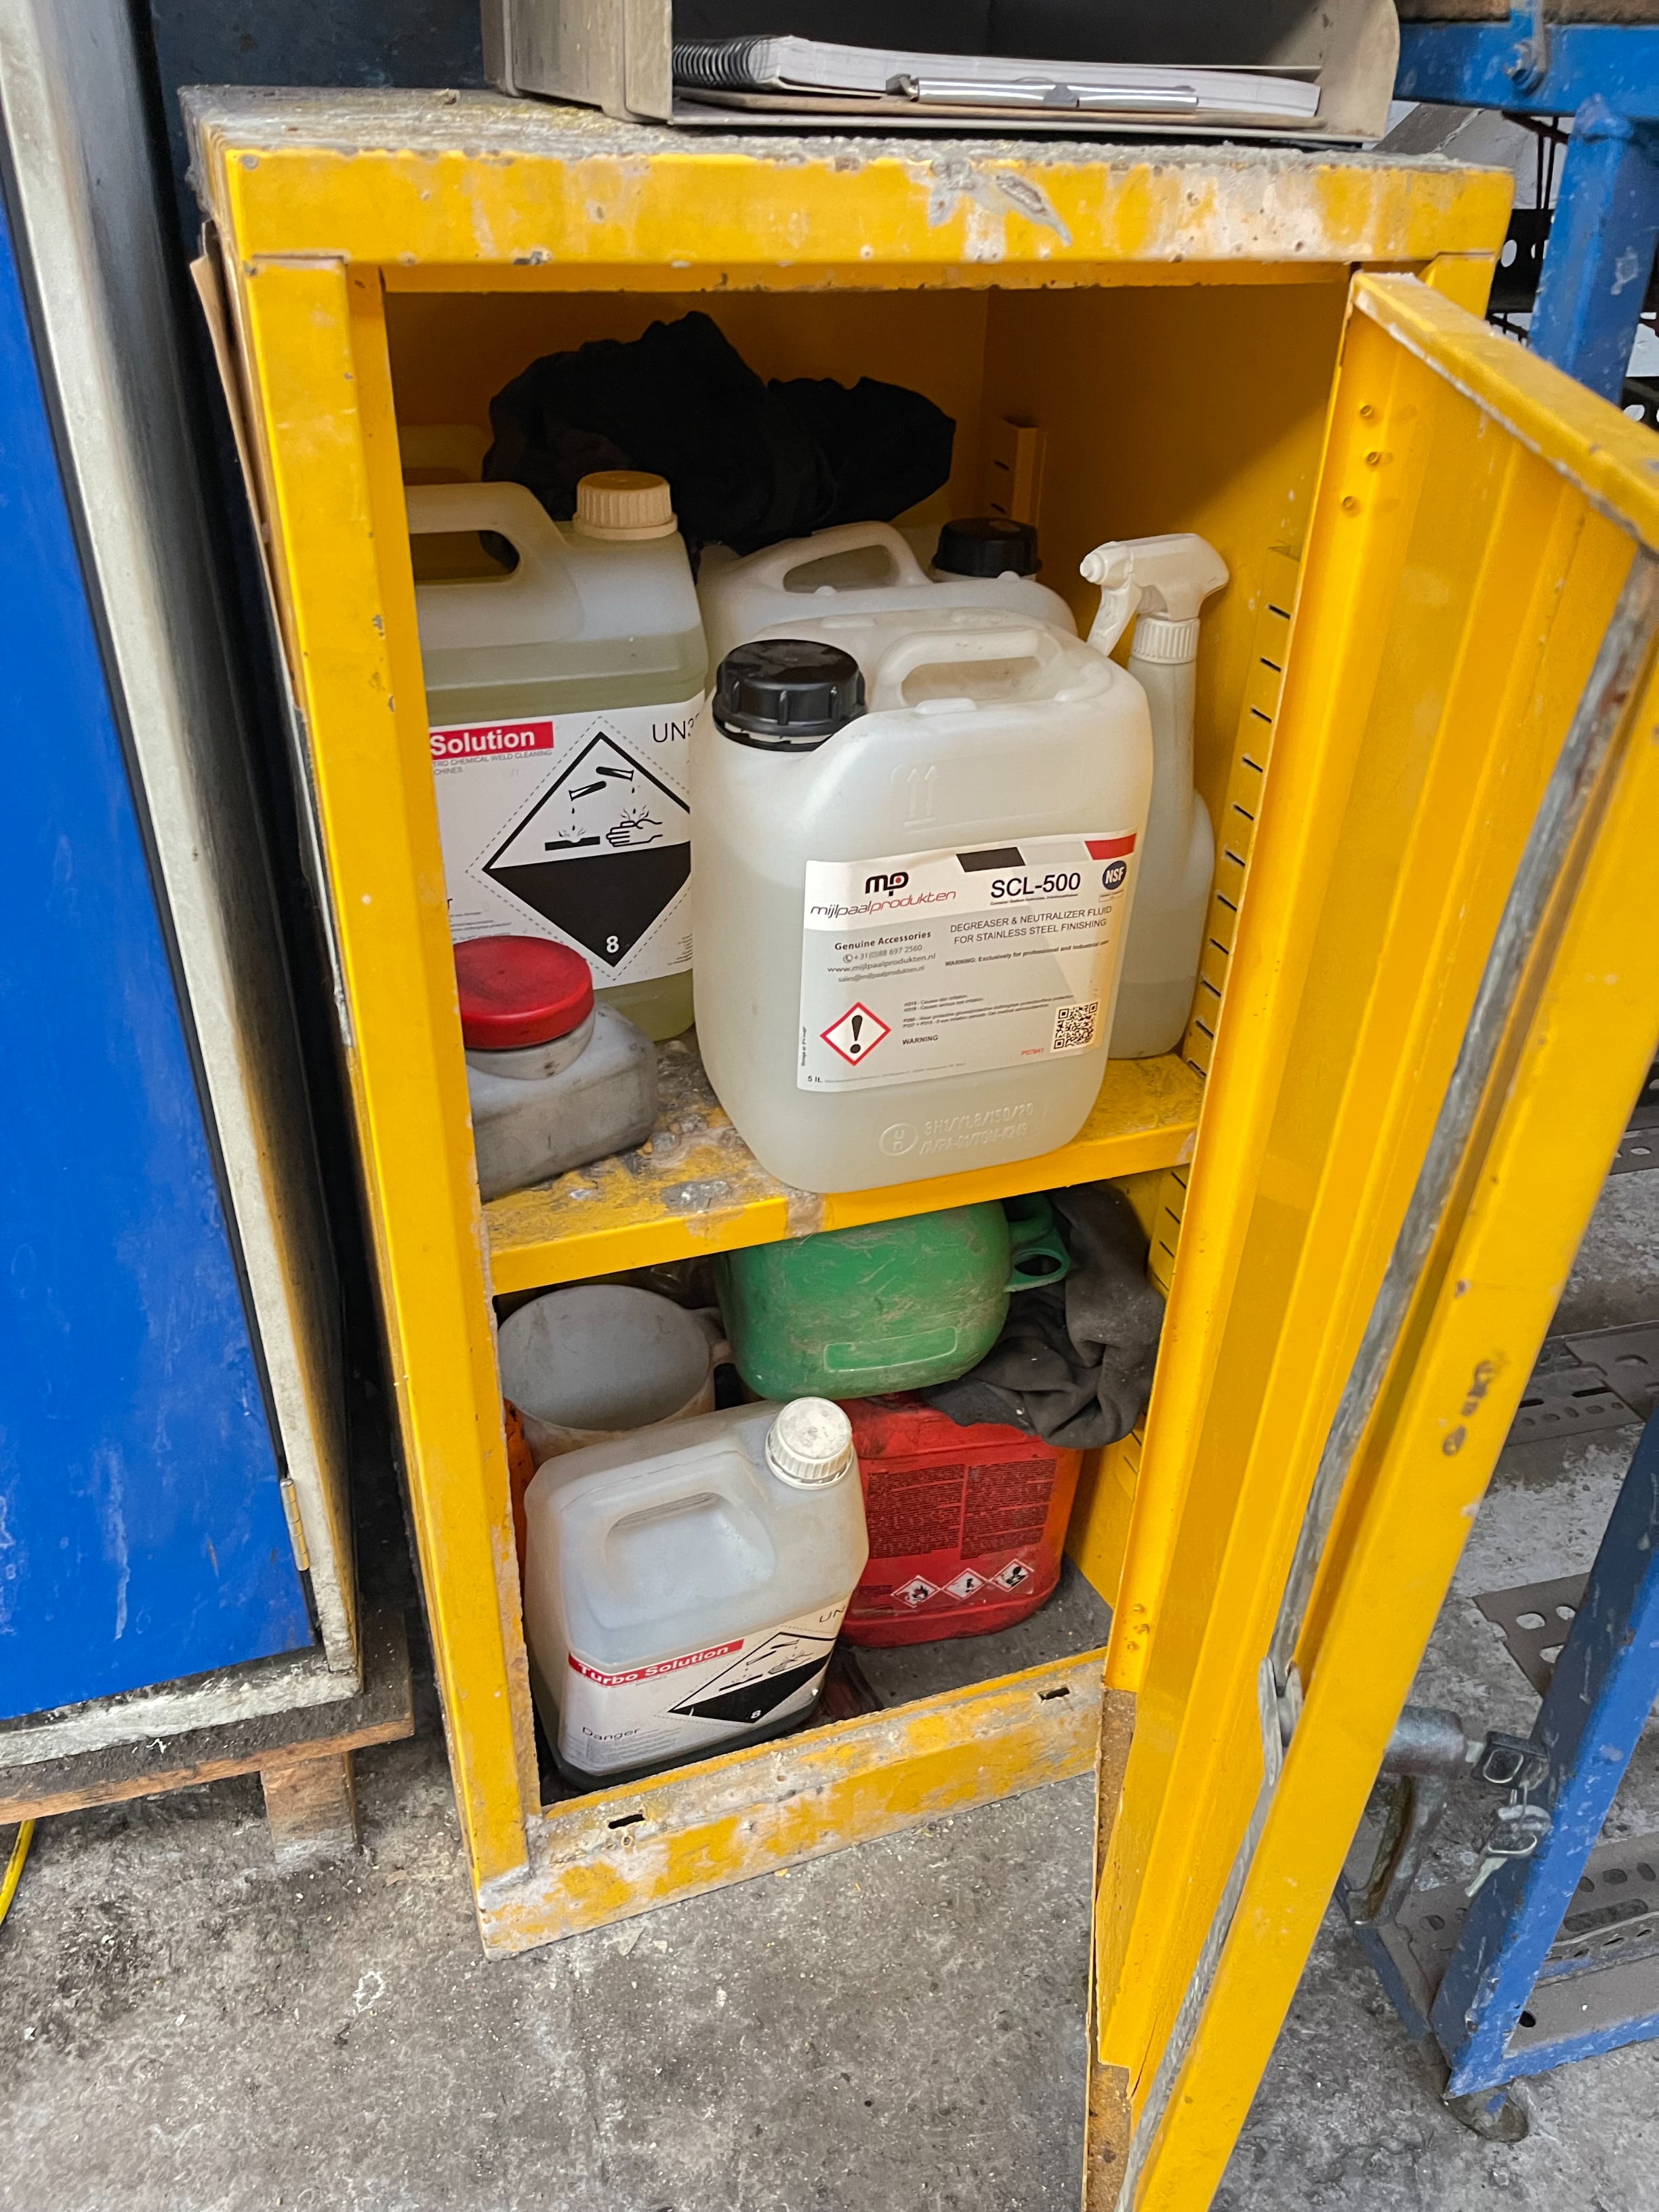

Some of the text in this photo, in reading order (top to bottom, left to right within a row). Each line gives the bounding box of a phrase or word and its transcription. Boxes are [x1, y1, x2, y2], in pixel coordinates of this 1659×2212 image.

[430, 729, 535, 756] Solution
[491, 753, 513, 761] WELD
[514, 749, 552, 759] CLEANING
[1105, 866, 1125, 884] NSF
[990, 872, 1081, 899] SCL-500
[810, 890, 956, 918] mijlpaalprodukten
[950, 918, 1009, 933] DEGREASER
[1020, 909, 1085, 924] NEUTRALIZER
[1087, 905, 1112, 917] FLUID
[835, 931, 931, 950] Genuine Accessories
[954, 918, 1107, 945] FOR STAINLESS STEEL FINISHING
[606, 935, 619, 953] 8
[889, 946, 903, 955] 697
[903, 1035, 939, 1045] WARNING
[578, 1663, 638, 1685] Turbo
[644, 1646, 729, 1677] Solution
[751, 1709, 762, 1719] 8
[582, 1726, 640, 1741] Danger
